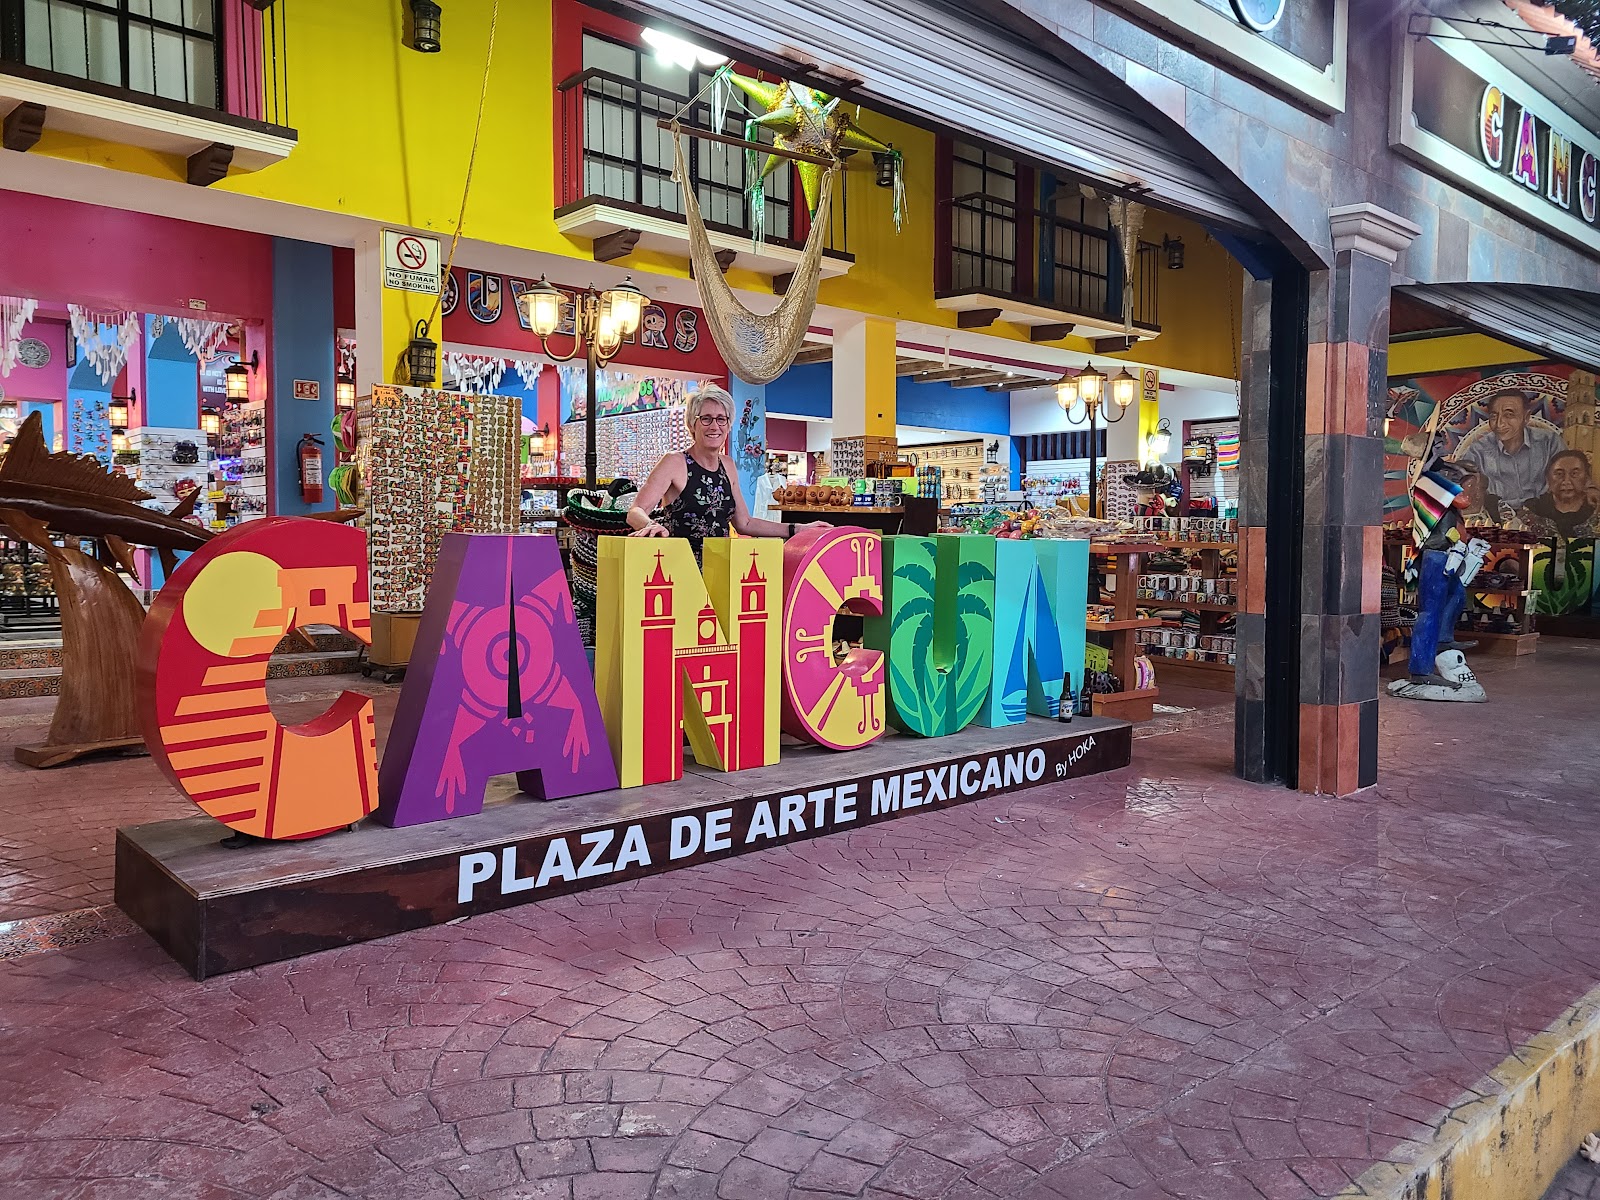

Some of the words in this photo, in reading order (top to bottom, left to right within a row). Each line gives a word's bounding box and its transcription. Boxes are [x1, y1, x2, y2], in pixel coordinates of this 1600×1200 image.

[402, 281, 436, 291] SMOKING
[404, 274, 435, 284] FUMAR
[141, 516, 1089, 841] CANCUN
[1055, 760, 1068, 778] By
[1068, 735, 1097, 767] HOKA
[458, 824, 652, 904] PLAZA
[669, 808, 733, 861] DE
[745, 783, 858, 844] ARTE
[870, 748, 1046, 817] MEXICANO
